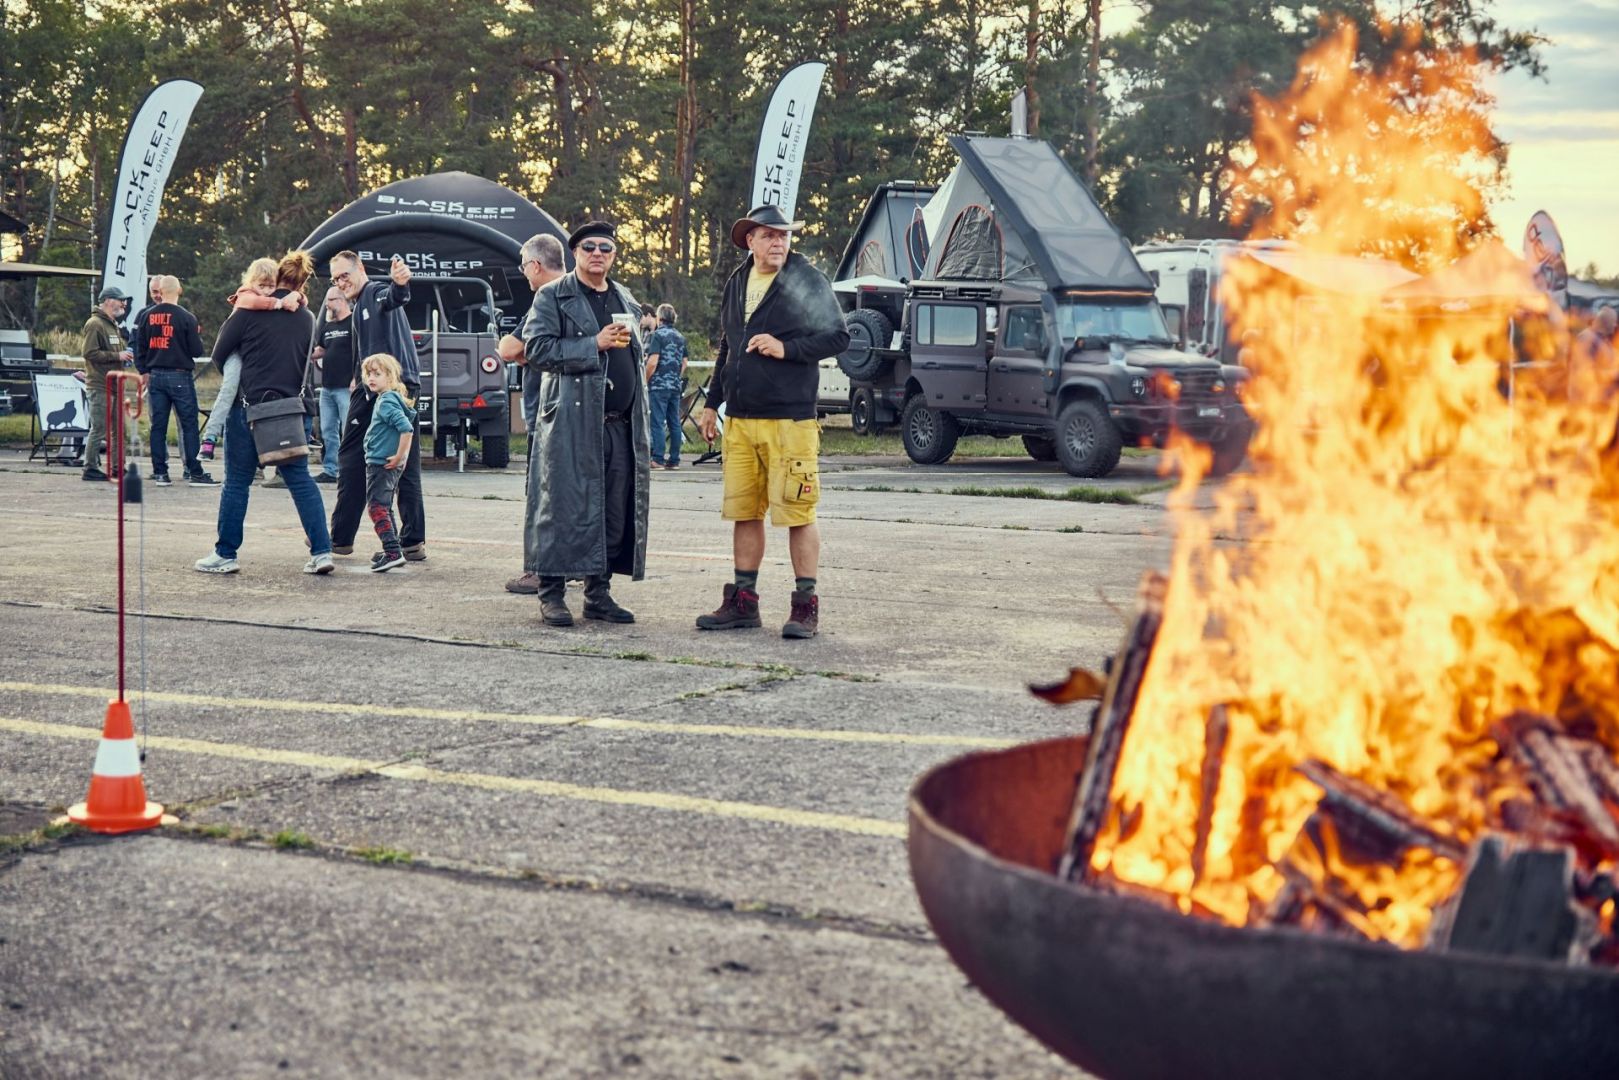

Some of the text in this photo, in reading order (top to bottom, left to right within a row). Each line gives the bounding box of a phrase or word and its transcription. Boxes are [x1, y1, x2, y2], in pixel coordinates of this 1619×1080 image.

[377, 194, 465, 211] BLACK
[115, 168, 142, 278] BLACK
[357, 250, 436, 266] BLACK
